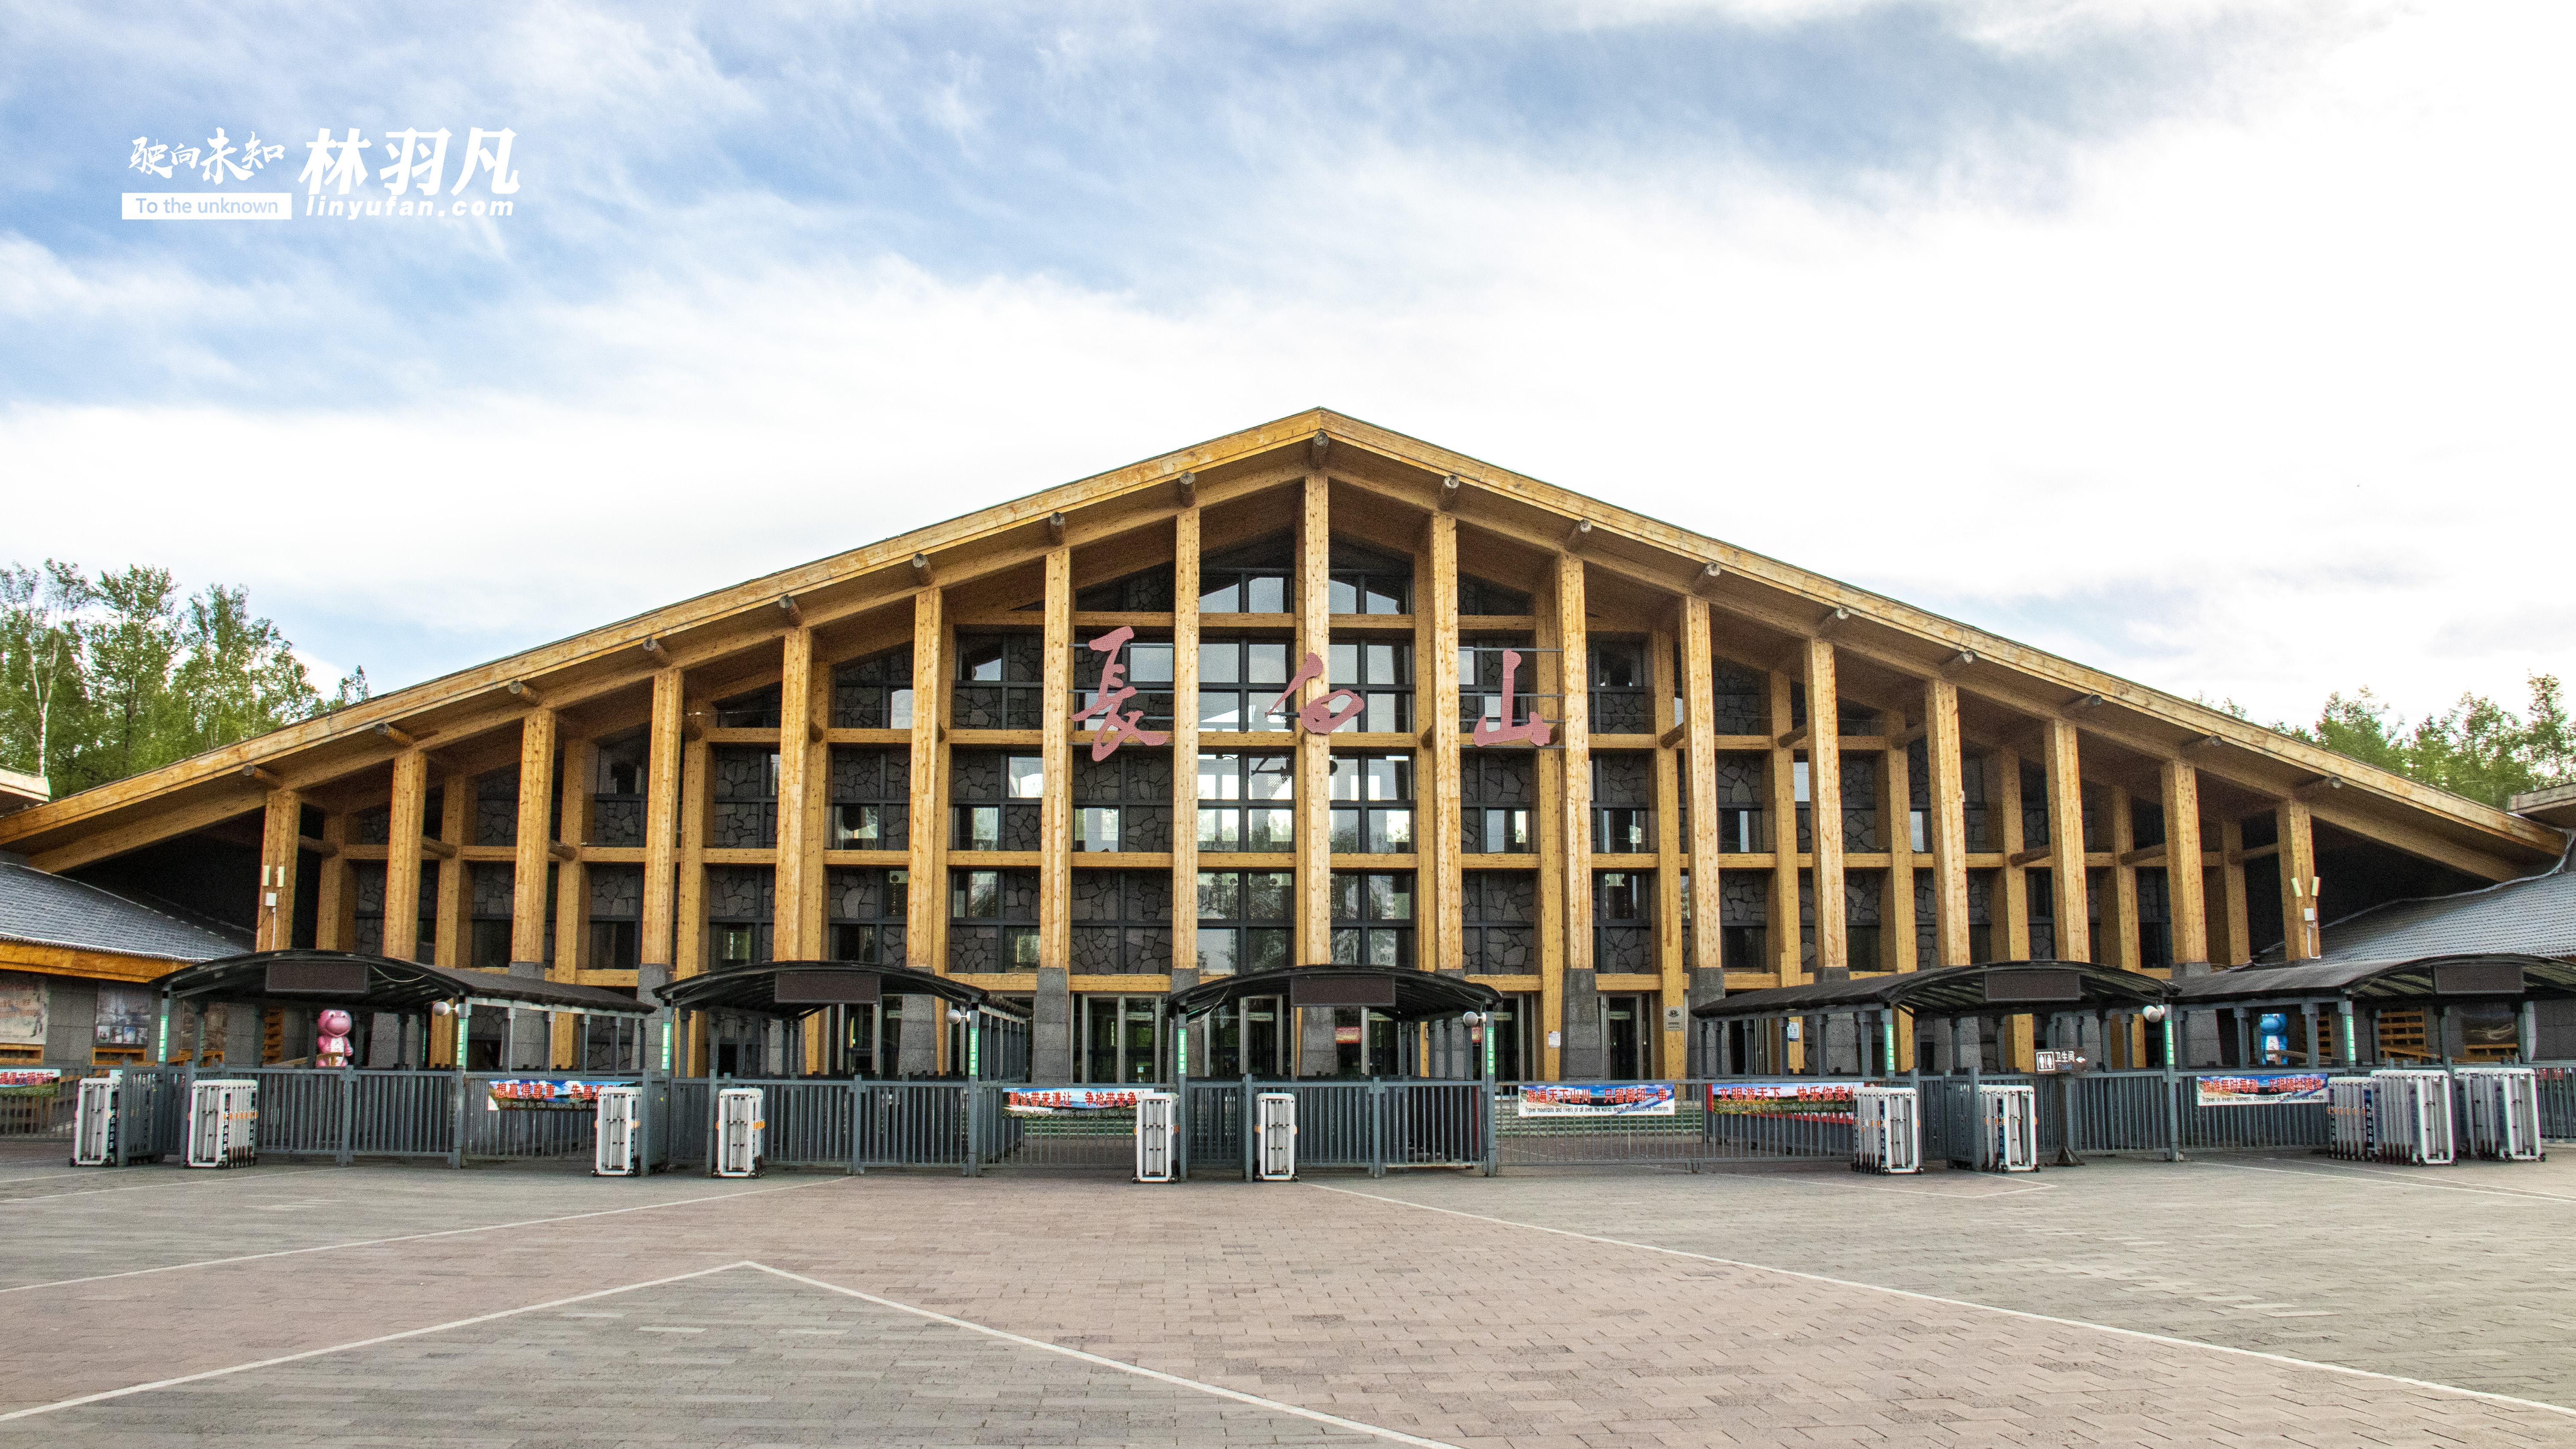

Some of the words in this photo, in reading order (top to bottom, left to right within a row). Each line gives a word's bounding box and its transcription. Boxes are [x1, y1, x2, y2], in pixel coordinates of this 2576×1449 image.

[2055, 1050, 2075, 1062] 卫生间
[495, 1082, 555, 1099] 想赢得尊重
[2203, 1078, 2259, 1094] 旅游每时每刻
[2268, 1076, 2322, 1093] 文明随时随地
[1009, 1091, 1072, 1107] 谦让带来谦让
[1084, 1091, 1138, 1107] 争抢带来争
[1526, 1089, 1591, 1104] 游遍天下山川
[1604, 1088, 1668, 1103] 只留脚印一串
[1719, 1087, 1781, 1102] 文明游天下
